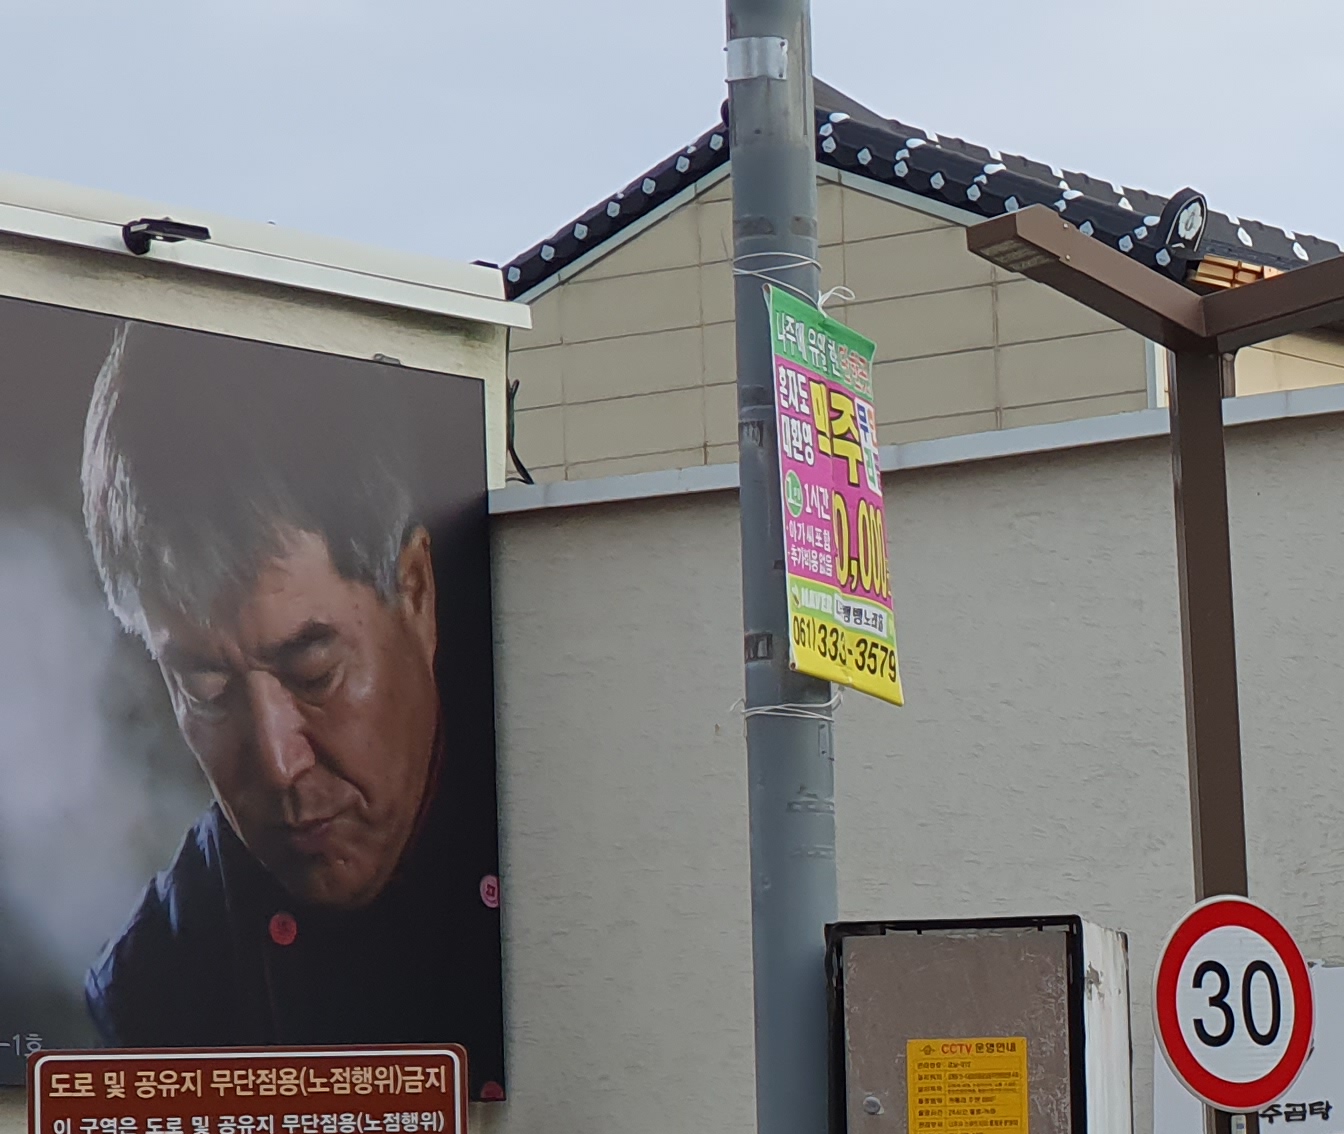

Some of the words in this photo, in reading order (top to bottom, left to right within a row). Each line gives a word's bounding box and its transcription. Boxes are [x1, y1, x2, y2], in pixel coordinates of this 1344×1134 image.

[778, 365, 811, 415] 혼자도
[781, 414, 815, 466] 대환영
[804, 483, 832, 521] 1시간
[1192, 960, 1282, 1047] 30
[941, 1043, 973, 1055] CCTV
[49, 1072, 96, 1097] 도로
[103, 1070, 127, 1098] 및
[134, 1069, 202, 1098] 공유지
[210, 1064, 447, 1096] 무단점용(노점행위)금지
[145, 1117, 184, 1134] 도로
[217, 1114, 274, 1134] 공유지
[281, 1110, 445, 1134] 무단점용(노점행위)
[1259, 1101, 1332, 1124] 주곰탕
